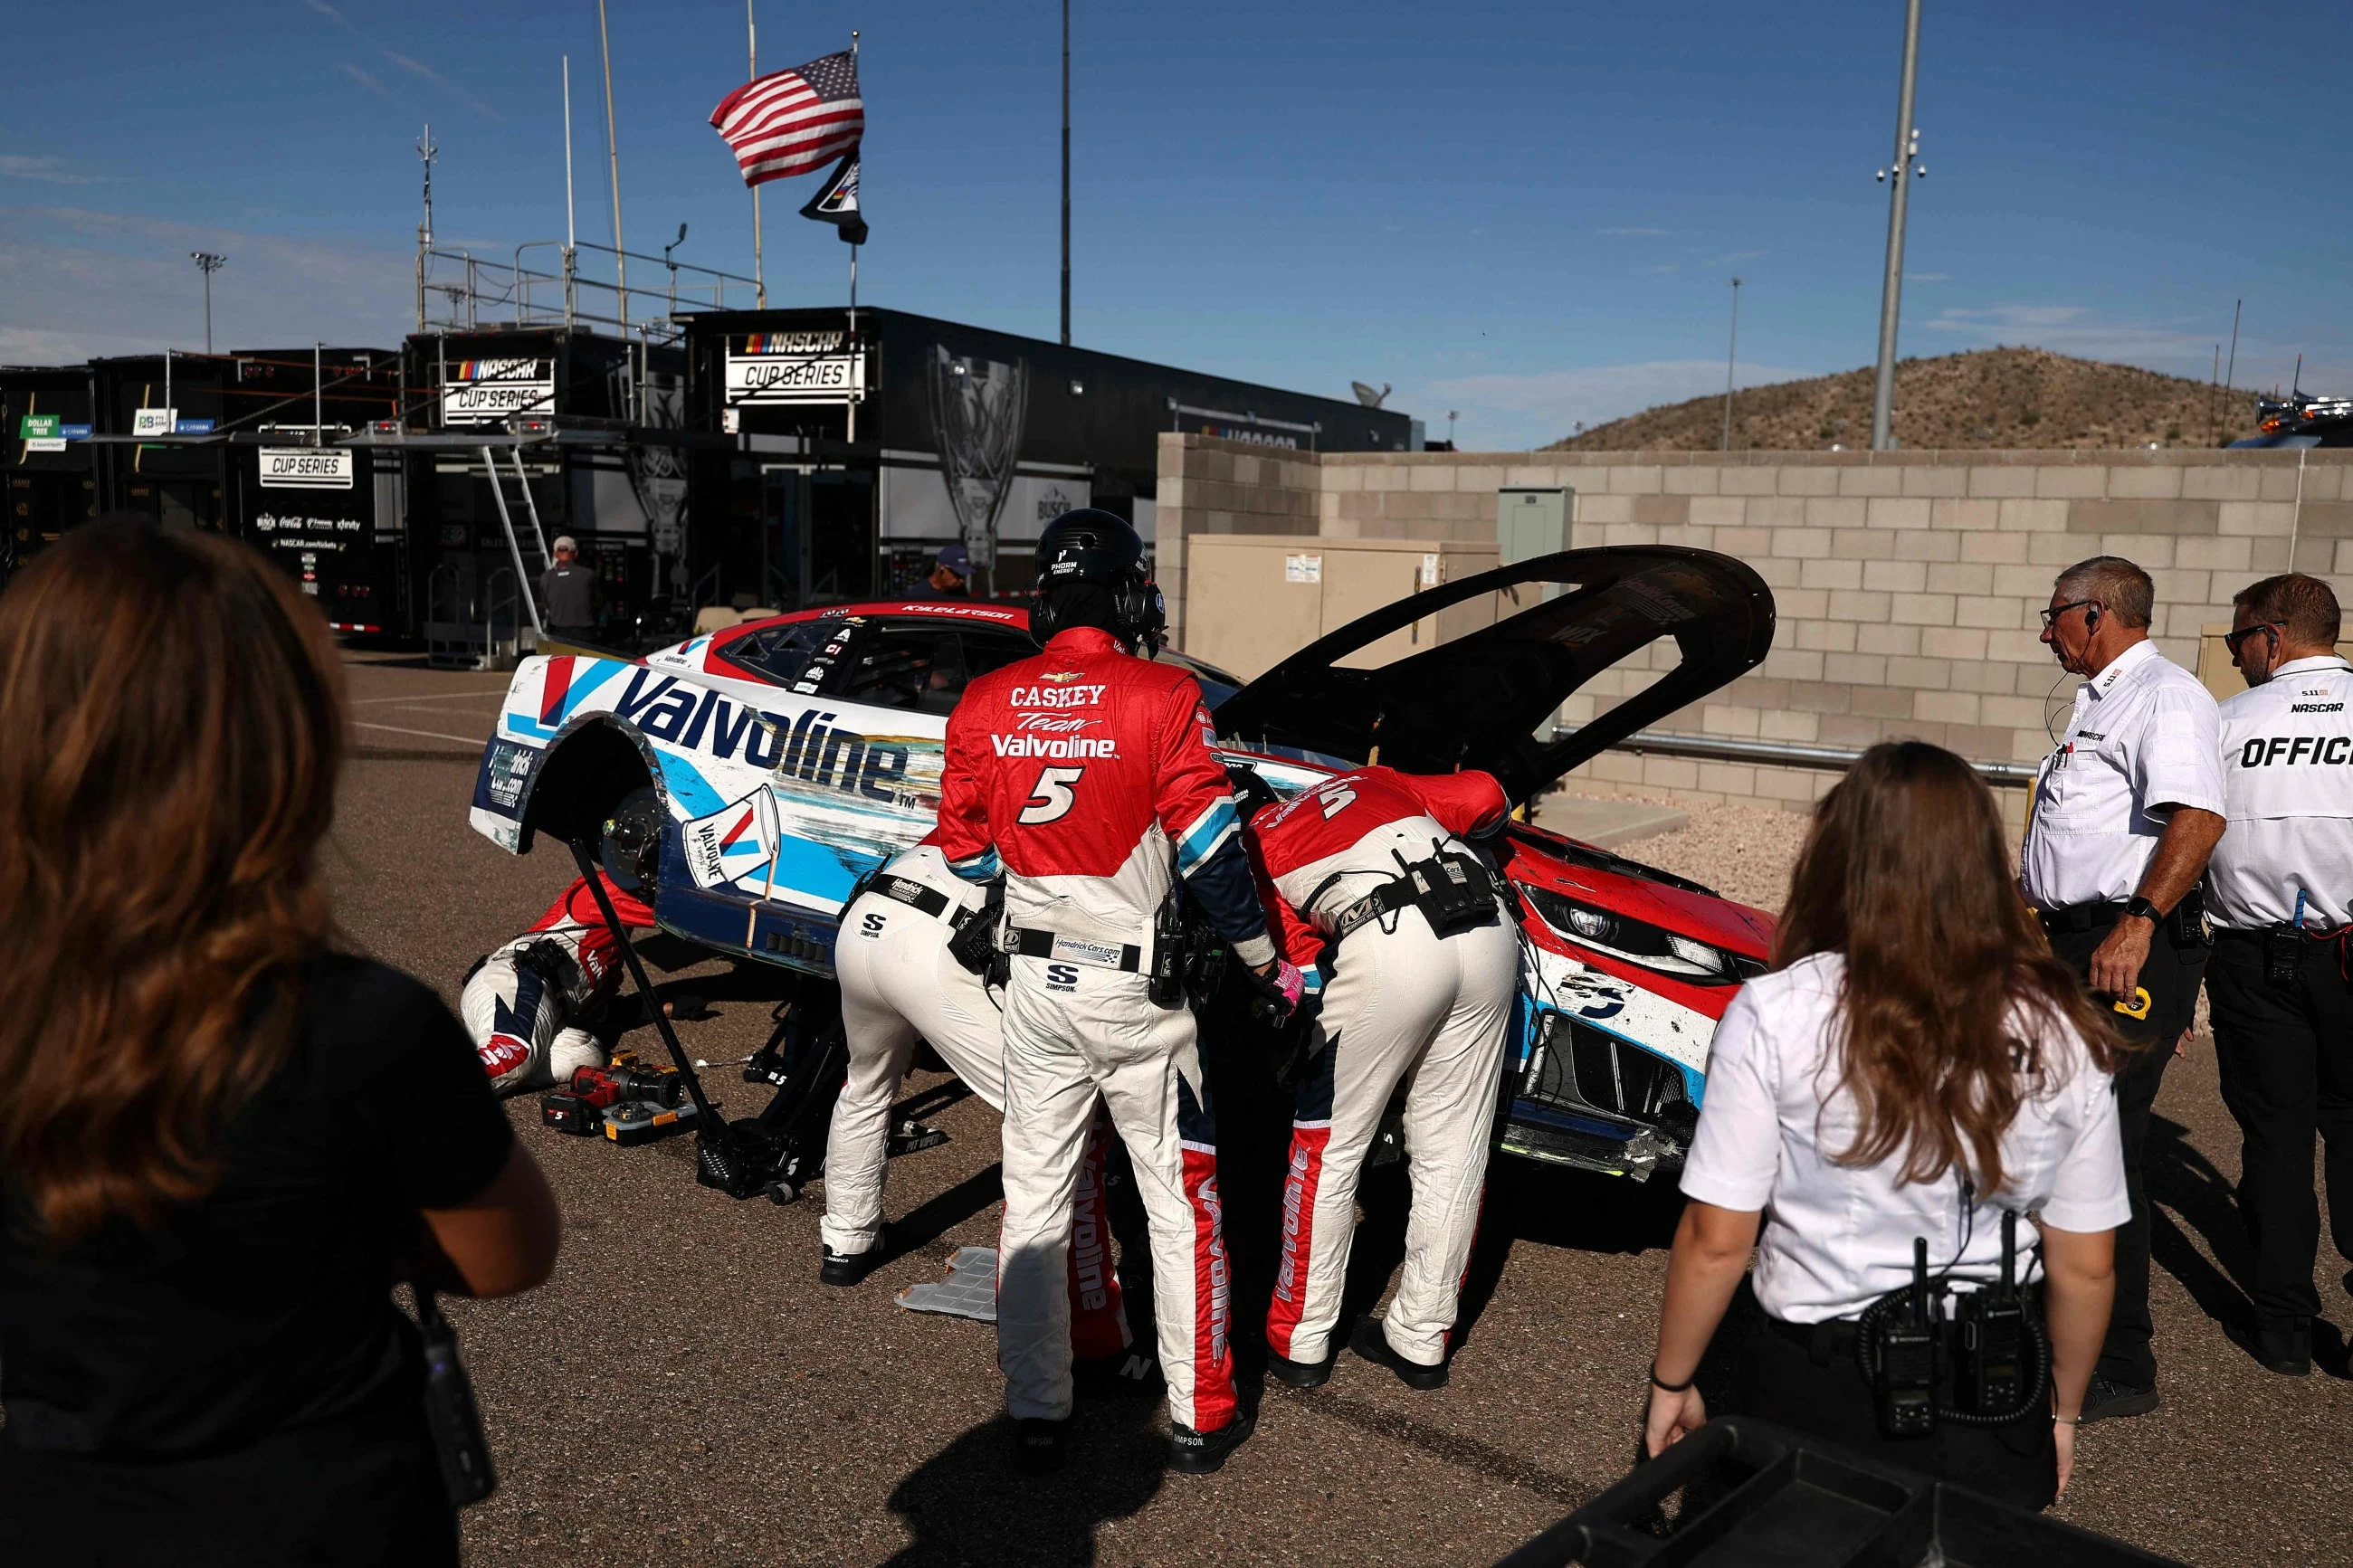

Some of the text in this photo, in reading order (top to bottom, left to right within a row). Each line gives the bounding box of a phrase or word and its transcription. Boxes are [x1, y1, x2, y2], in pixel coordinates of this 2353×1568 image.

[768, 331, 843, 353] NASCAR
[477, 357, 538, 379] NASCAR
[745, 364, 844, 385] CUP SERIES
[459, 389, 538, 408] CUP SERIES
[28, 418, 52, 427] DOLLAR
[32, 427, 48, 436] TREE
[272, 458, 339, 475] CUP SERIES
[1051, 561, 1078, 571] PHORM
[664, 655, 688, 666] Valvoline
[1010, 684, 1107, 708] CASKEY
[2291, 702, 2345, 713] NASCAR
[1016, 712, 1103, 733] Team
[614, 667, 909, 804] Valvoline
[990, 733, 1116, 759] Valvoline
[2241, 736, 2353, 769] OFFIC
[1015, 765, 1087, 826] 5
[1318, 783, 1358, 822] 5
[862, 913, 887, 931] S
[1047, 964, 1080, 984] S
[1045, 982, 1076, 993] SIMPSON
[554, 1110, 564, 1121] 5
[906, 1133, 940, 1153] PIT VIPER
[1275, 1144, 1309, 1303] Valvoline
[1197, 1173, 1226, 1361] Valvoline
[1173, 1433, 1205, 1447] SIMPSON
